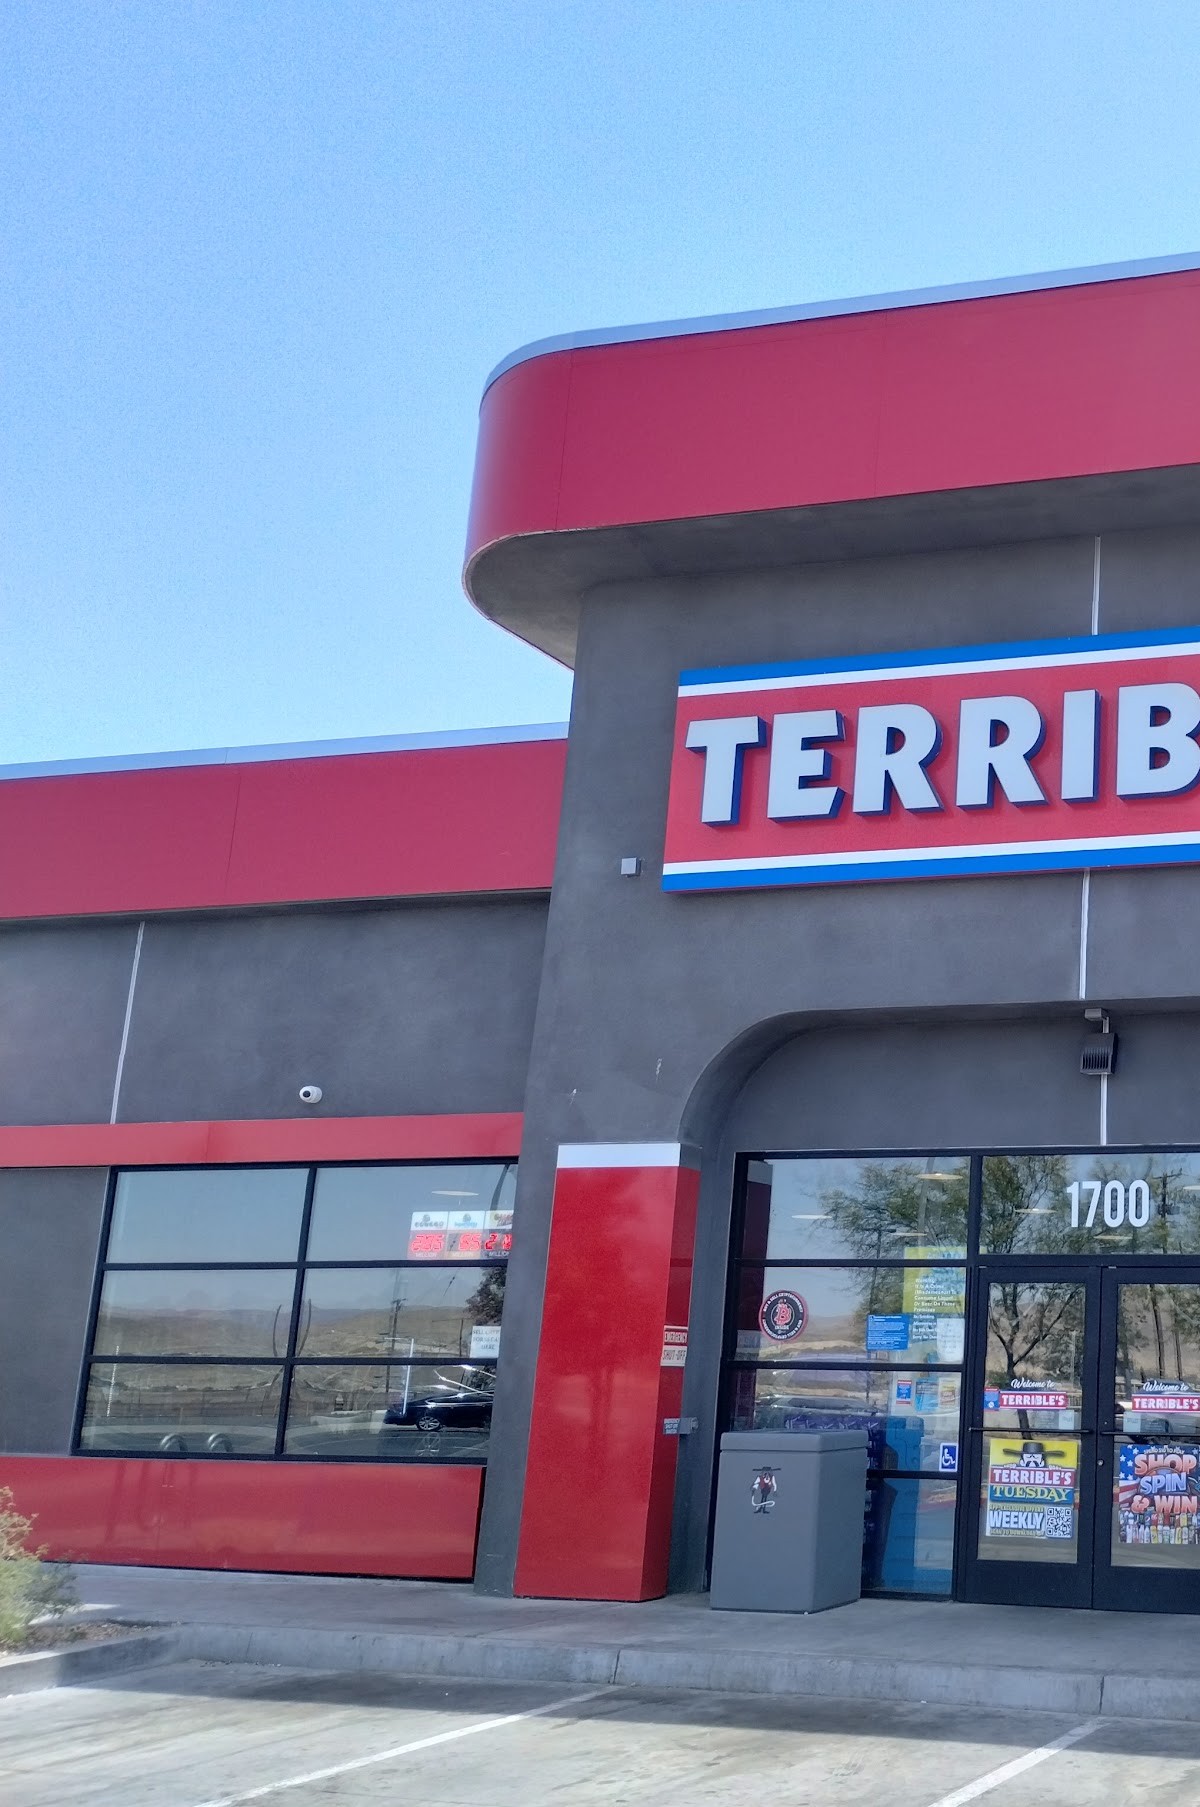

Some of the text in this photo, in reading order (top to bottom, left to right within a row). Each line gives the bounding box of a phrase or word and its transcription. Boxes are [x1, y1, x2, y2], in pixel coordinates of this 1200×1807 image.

[1066, 1179, 1150, 1228] 1700
[1010, 1376, 1055, 1388] Welcome to
[1142, 1380, 1189, 1392] Welcome to
[1001, 1394, 1065, 1406] TERRIBLE'S
[1133, 1398, 1199, 1410] TERRIBLE'S
[1134, 1453, 1197, 1475] SHOP
[993, 1469, 1072, 1485] TERRIBLE'S
[1140, 1471, 1187, 1495] SPIN
[993, 1485, 1072, 1502] TUESDAY
[1131, 1495, 1198, 1514] & WIN
[990, 1511, 1044, 1530] WEEKLY
